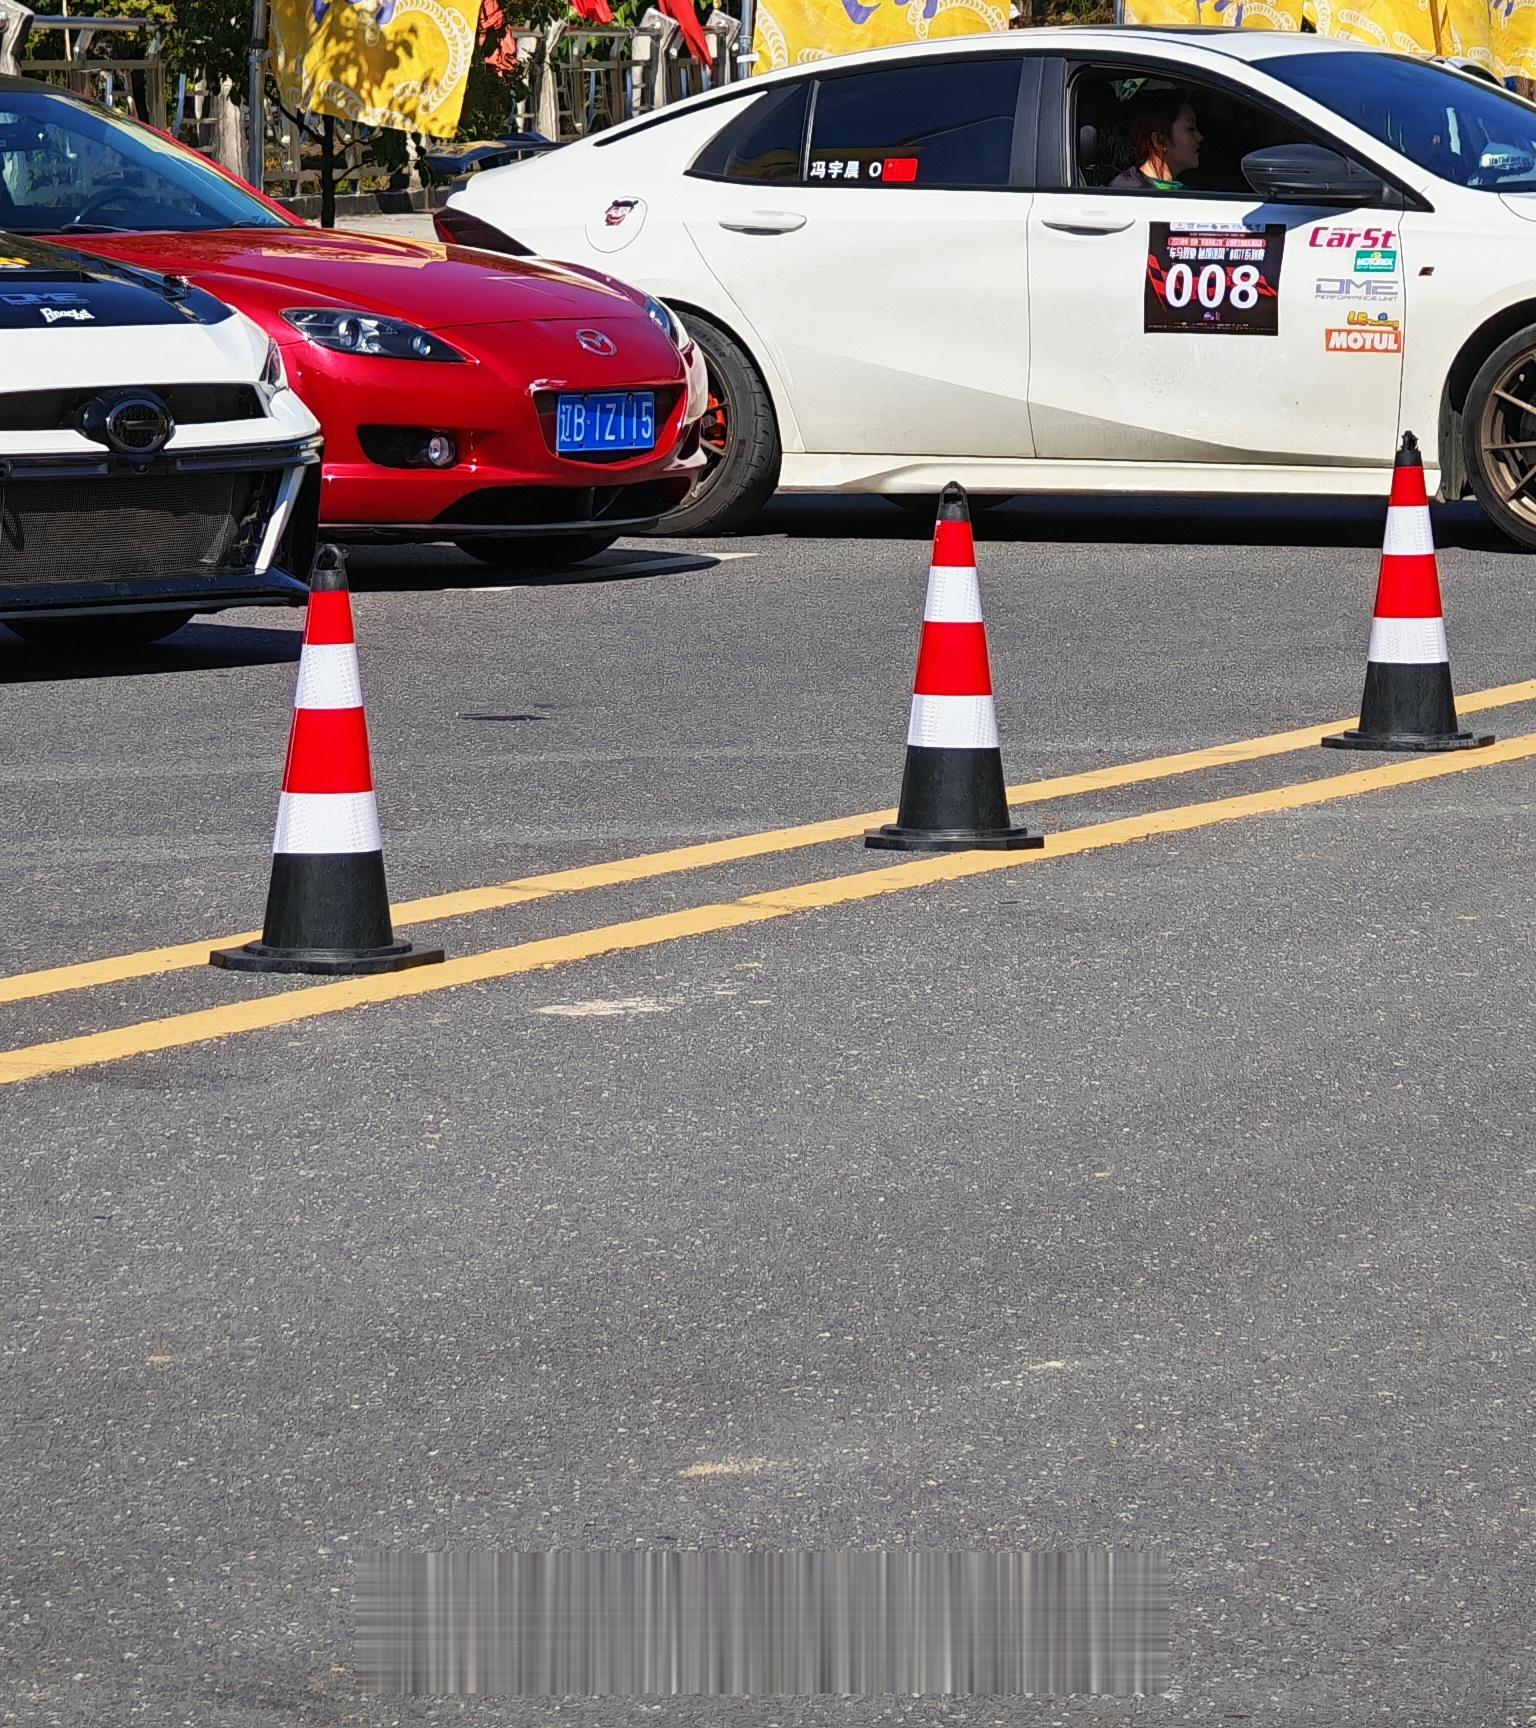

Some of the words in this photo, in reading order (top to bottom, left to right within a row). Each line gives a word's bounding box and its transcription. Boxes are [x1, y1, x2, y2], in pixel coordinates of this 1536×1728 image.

[1166, 263, 1260, 309] 008
[1316, 278, 1398, 295] DME
[1329, 331, 1399, 350] MOTUL
